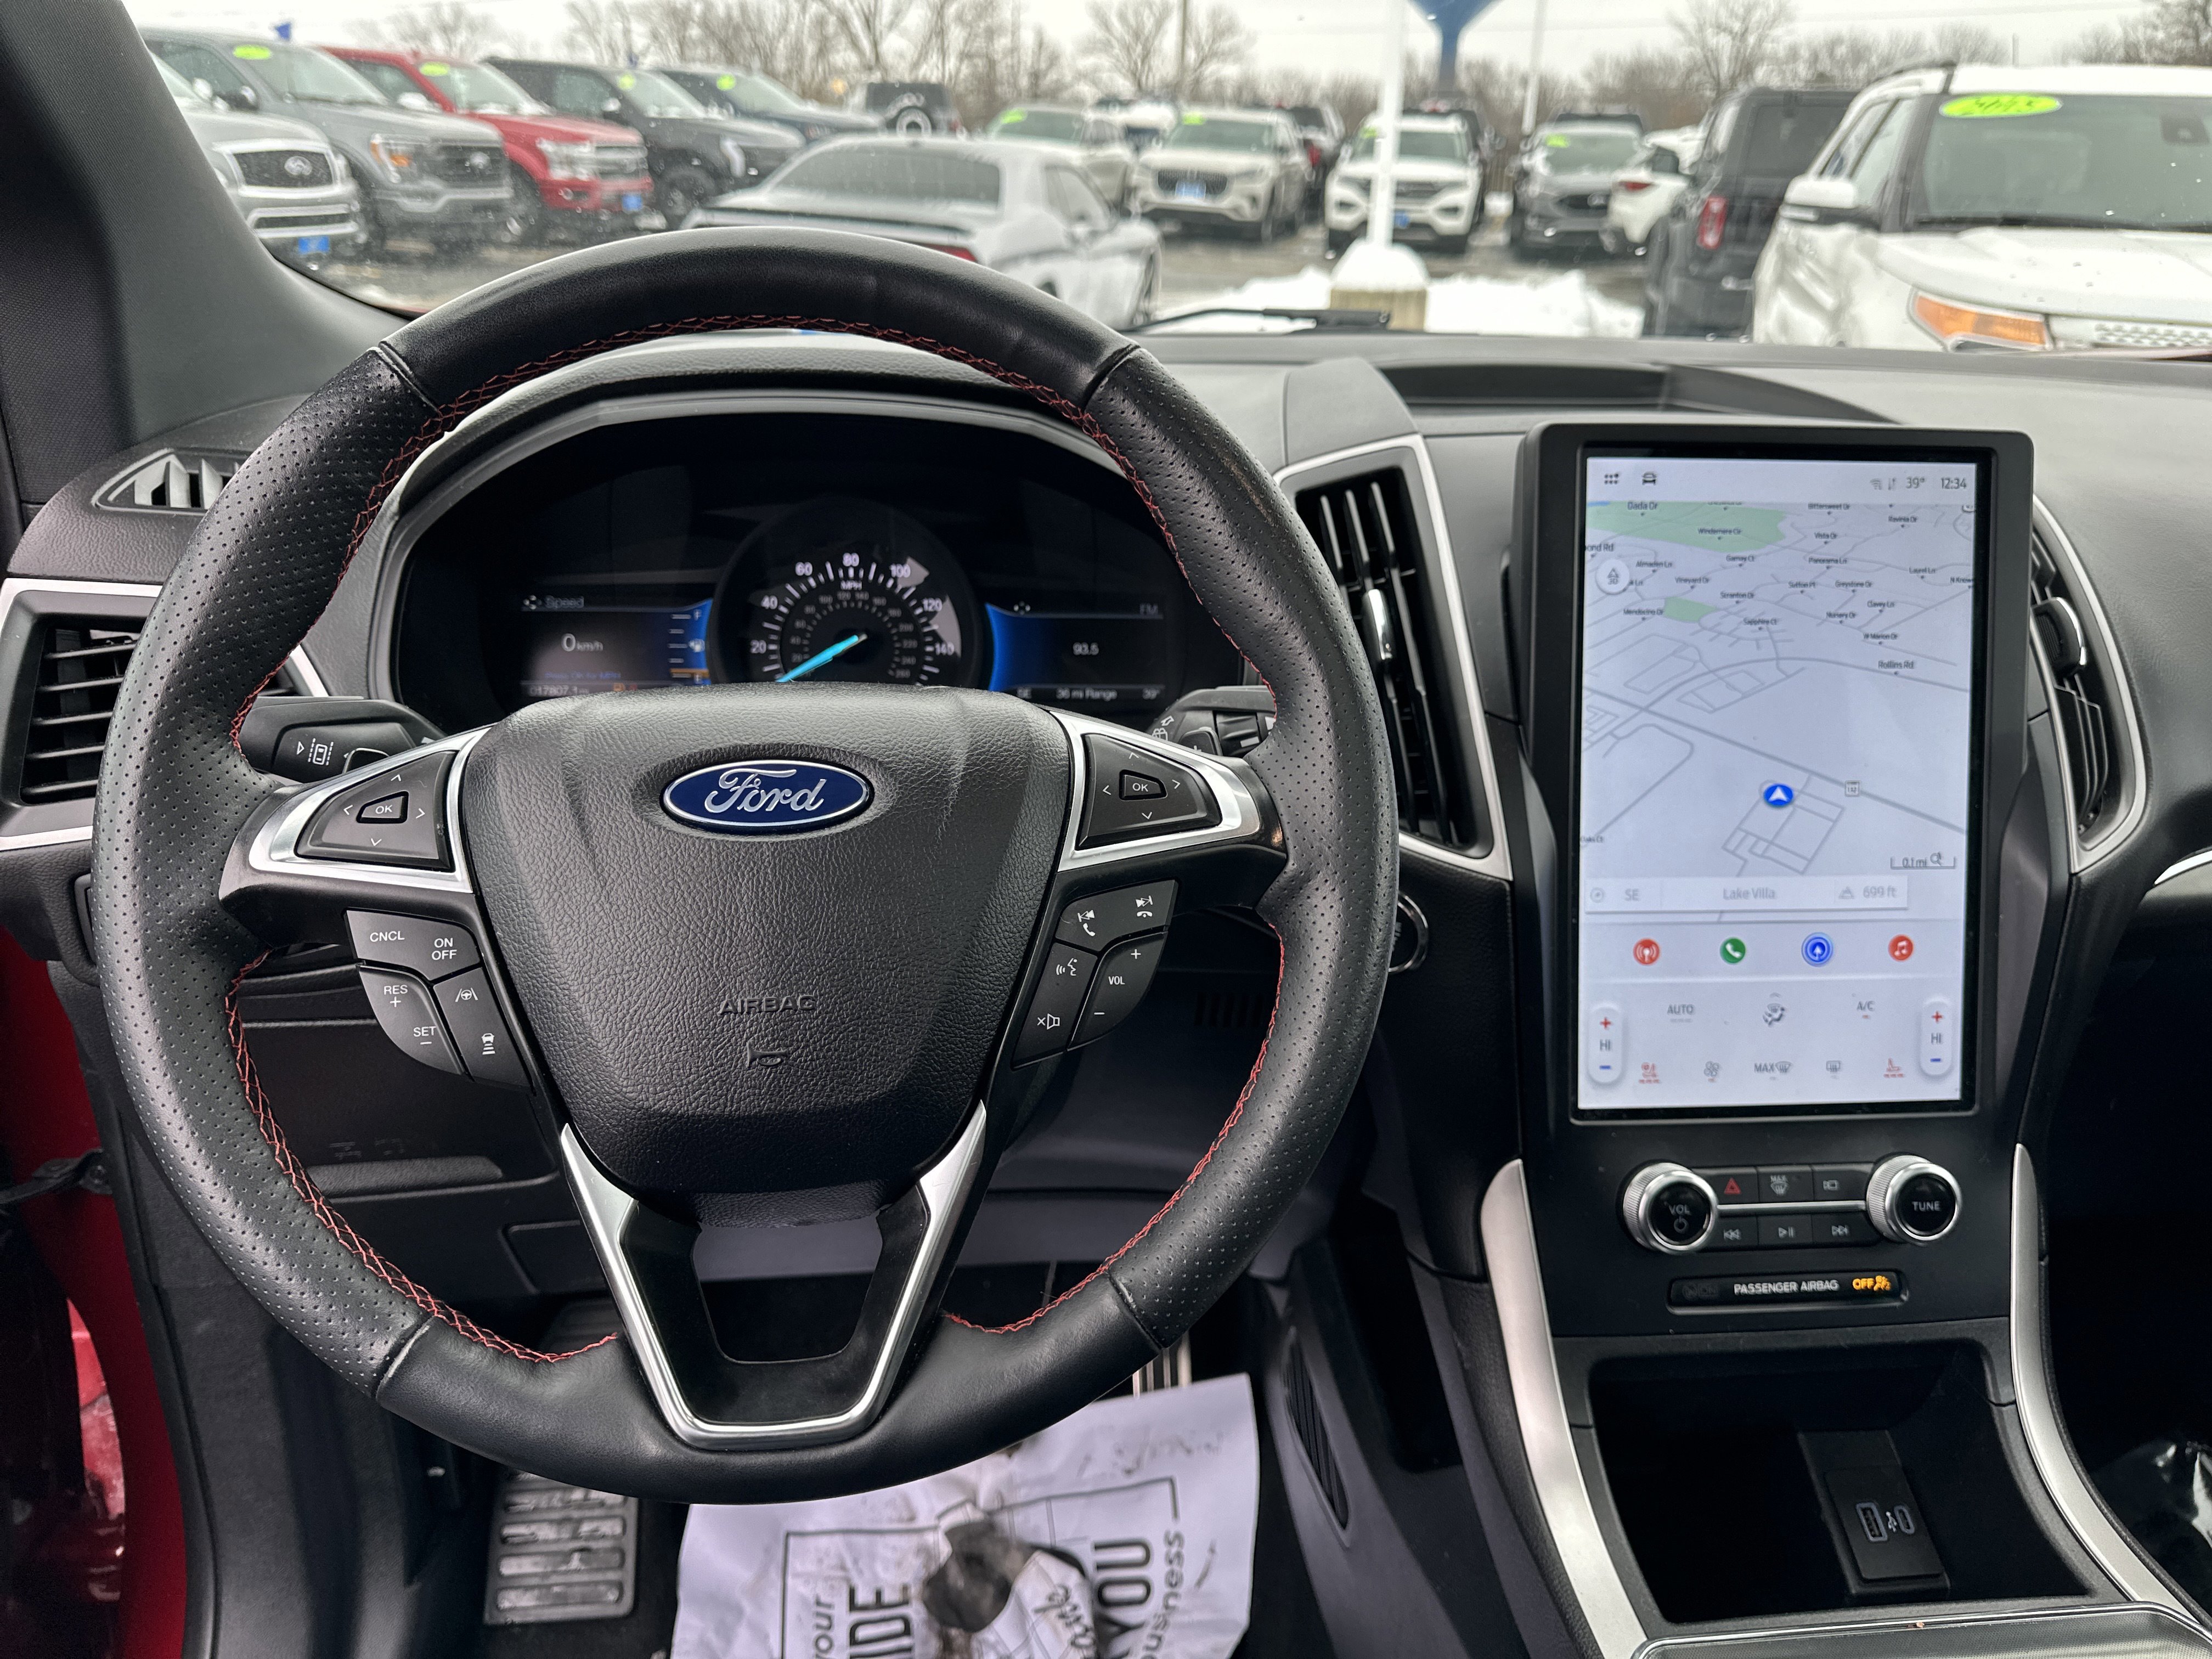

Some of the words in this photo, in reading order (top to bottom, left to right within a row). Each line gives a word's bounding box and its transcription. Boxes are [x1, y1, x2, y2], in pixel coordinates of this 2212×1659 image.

[1906, 476, 1926, 489] 39°
[1941, 477, 1967, 489] 12:34
[1649, 501, 1658, 510] Dr
[1603, 544, 1614, 552] Rd
[843, 552, 860, 567] 80
[795, 561, 813, 576] 60
[890, 563, 911, 578] 100
[840, 580, 862, 590] MPH
[545, 595, 584, 610] Speed
[761, 595, 778, 610] 40
[921, 597, 943, 612] 120
[750, 640, 767, 654] 20
[935, 641, 955, 655] 140
[1073, 642, 1099, 656] 93.5
[1904, 661, 1914, 669] Rd
[1071, 689, 1084, 699] mi
[1085, 687, 1118, 701] Range
[704, 768, 827, 813] Ford
[1132, 782, 1148, 792] OK
[375, 805, 393, 814] OK
[1624, 888, 1639, 901] SE
[1723, 888, 1750, 900] Lake
[1751, 887, 1776, 900] Villa
[1863, 886, 1886, 899] 699
[1887, 885, 1897, 898] ft
[370, 930, 405, 942] CNCL
[434, 938, 453, 948] ON
[431, 950, 457, 960] OFF
[1108, 976, 1125, 985] VOL
[384, 985, 408, 995] RES
[719, 995, 817, 1015] AIRBAG
[1667, 1004, 1695, 1015] AUTO
[1857, 1001, 1875, 1011] A/C
[413, 1026, 436, 1036] SET
[1931, 1033, 1942, 1044] HI
[1599, 1039, 1611, 1051] HI
[1754, 1063, 1774, 1073] MAX
[1668, 1204, 1691, 1216] VOL
[1912, 1200, 1941, 1212] TUNE
[1734, 1281, 1798, 1295] PASSENGER
[1800, 1279, 1838, 1292] AIRBAG
[1852, 1278, 1874, 1290] OFF
[815, 1593, 834, 1659] our
